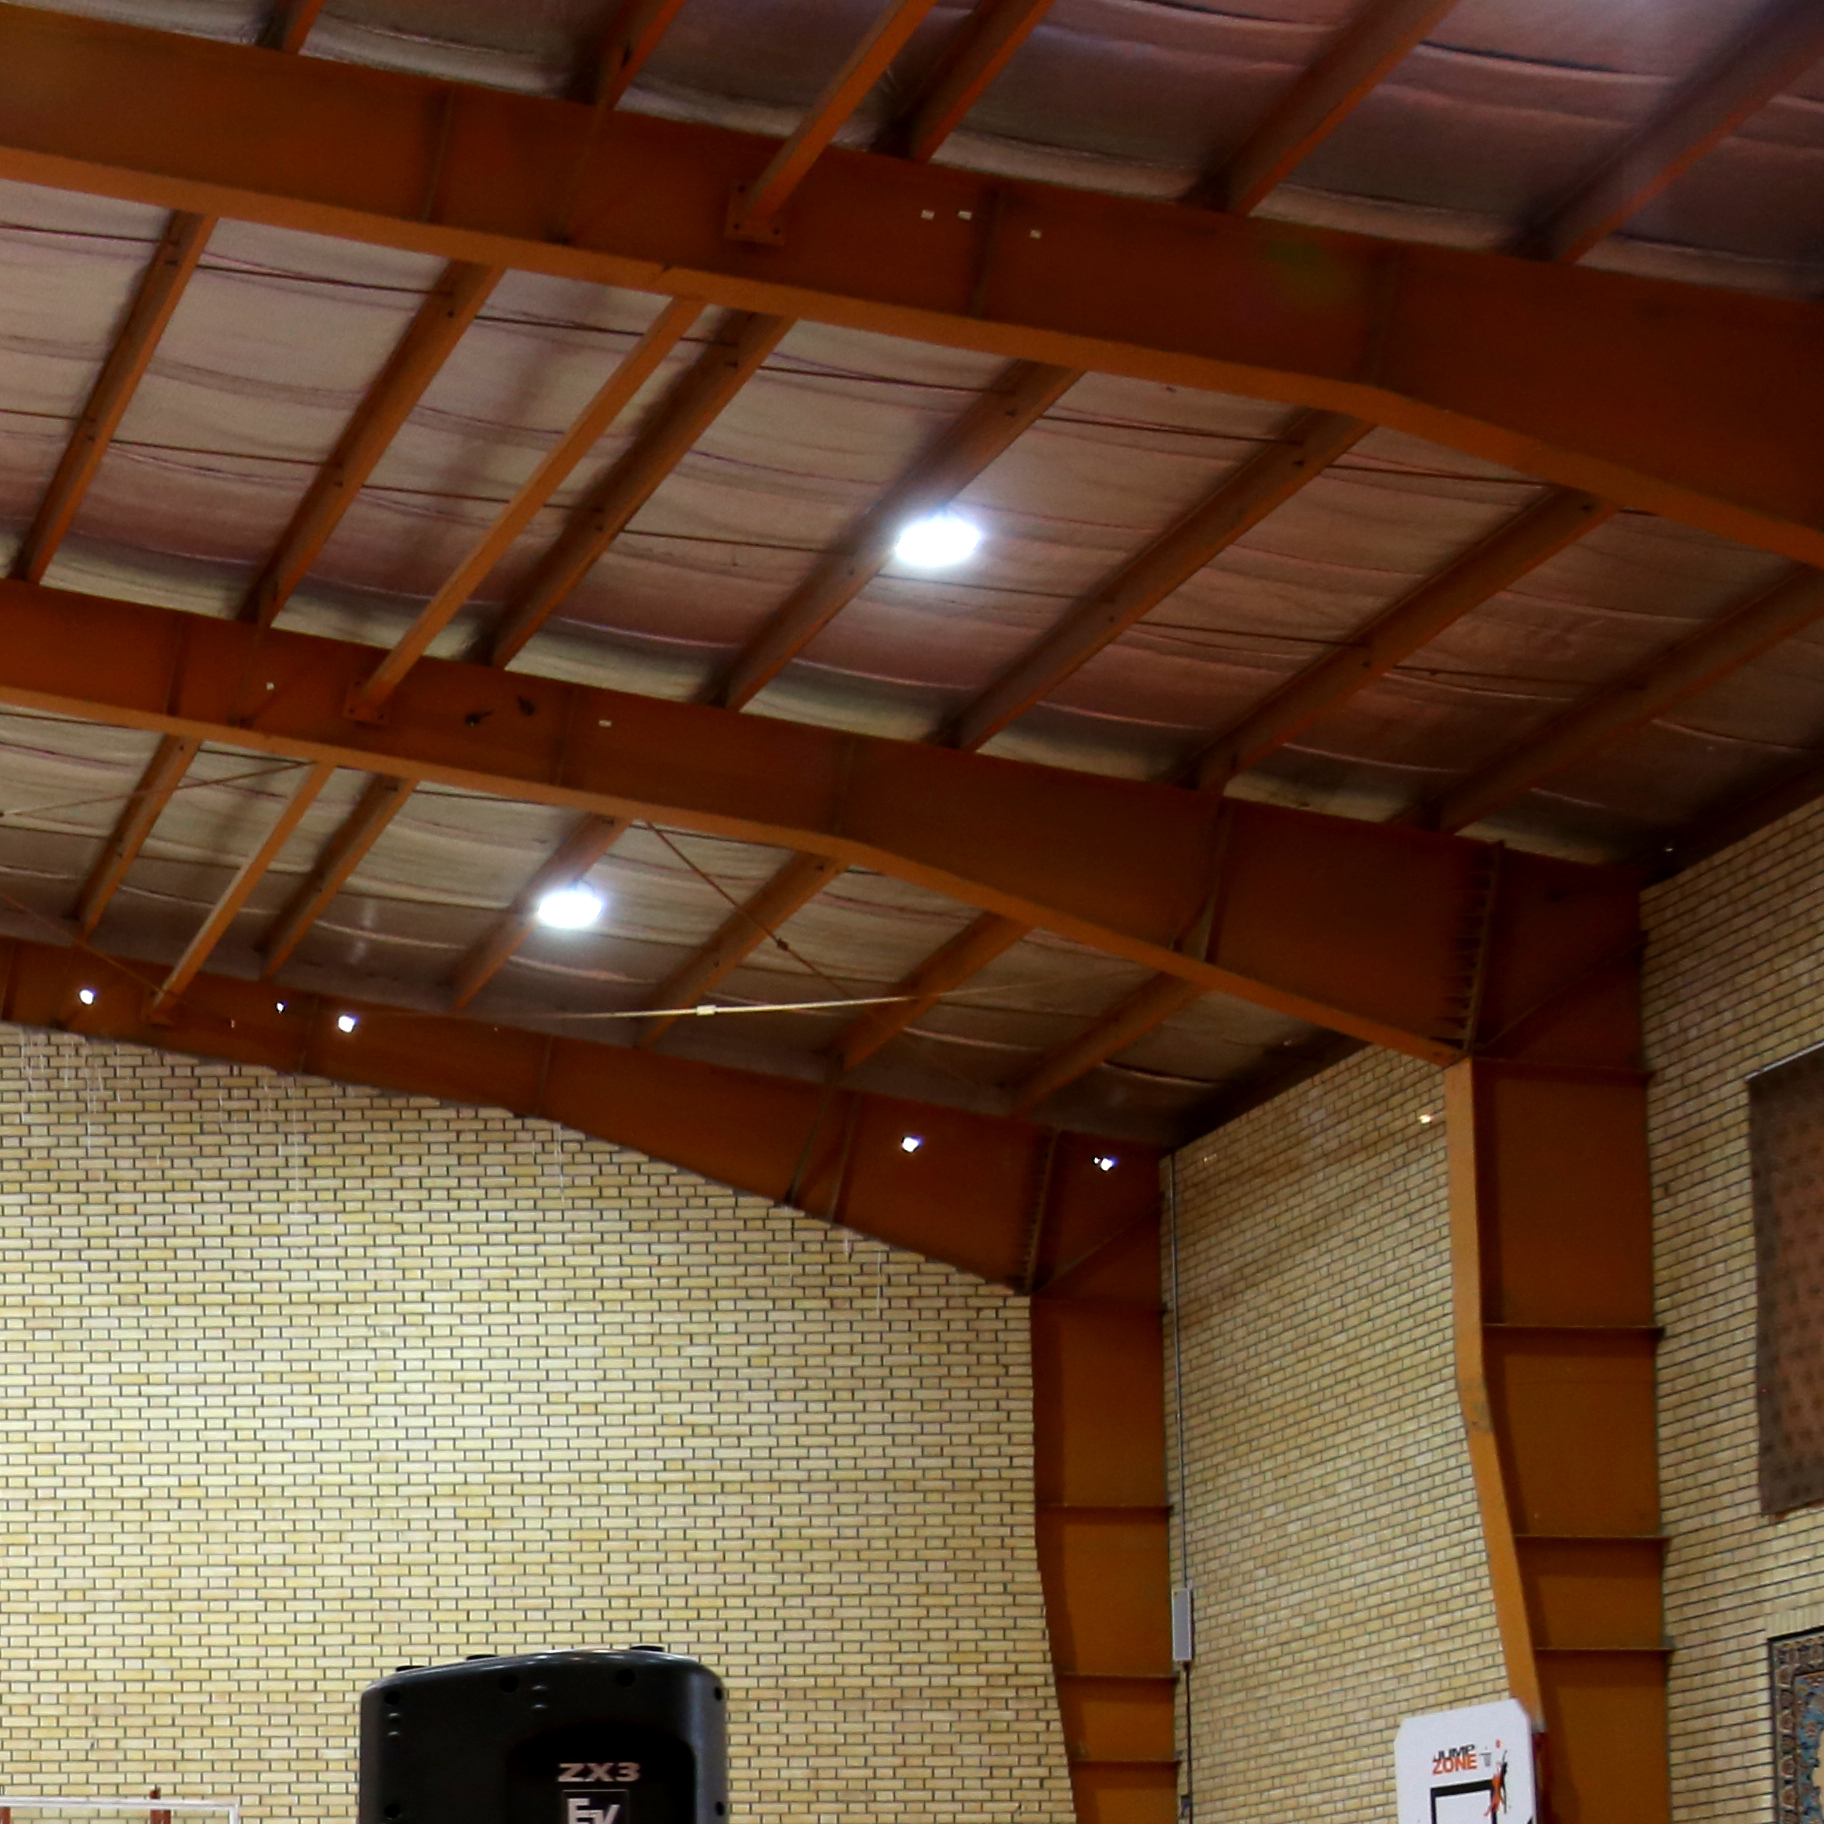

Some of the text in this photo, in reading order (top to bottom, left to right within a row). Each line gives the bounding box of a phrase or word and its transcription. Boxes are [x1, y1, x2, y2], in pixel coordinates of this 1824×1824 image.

[1433, 1744, 1475, 1762] JUMP
[557, 1762, 640, 1782] ZX3
[1432, 1754, 1477, 1775] ZONE
